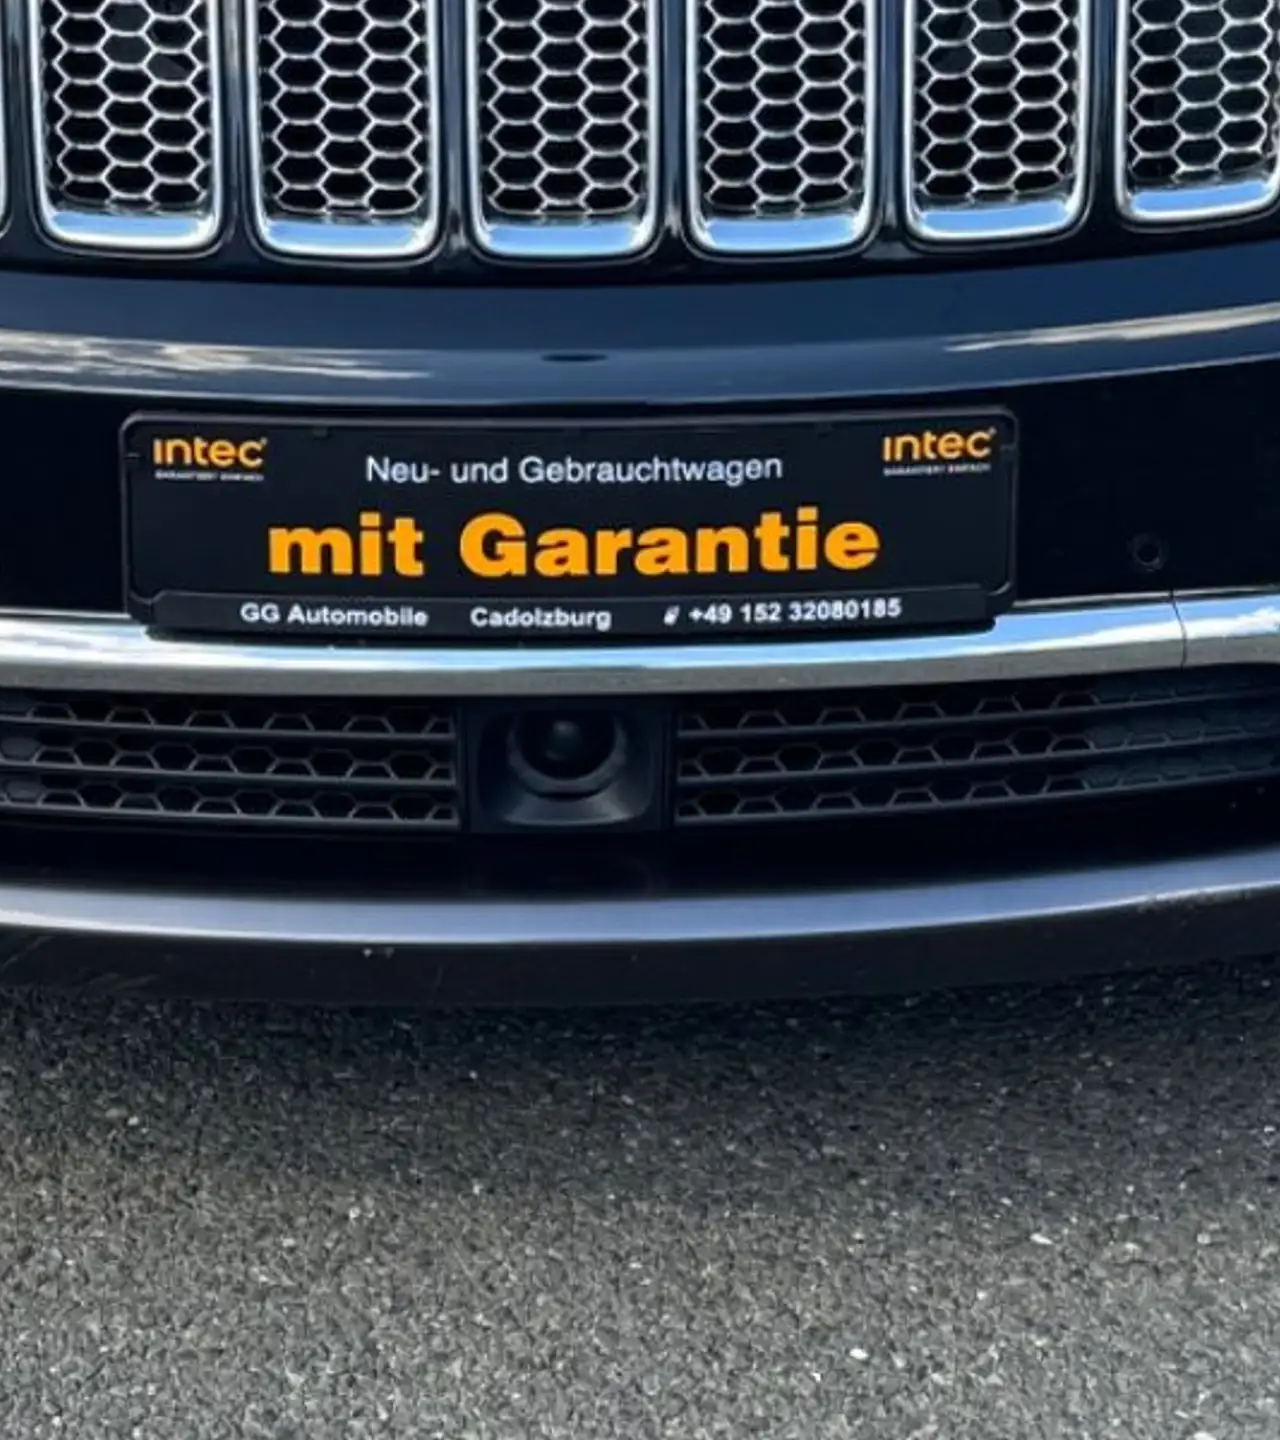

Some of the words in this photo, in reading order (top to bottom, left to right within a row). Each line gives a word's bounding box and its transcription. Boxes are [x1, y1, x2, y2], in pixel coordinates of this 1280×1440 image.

[153, 436, 264, 468] intec
[883, 429, 992, 462] intec
[366, 455, 440, 484] Neu-
[451, 456, 509, 484] und
[518, 455, 783, 487] Gebrauchtwagen
[269, 511, 424, 577] mit
[459, 505, 881, 578] Garantie
[240, 601, 281, 623] GG
[286, 603, 430, 627] Automobile
[470, 606, 613, 632] Cadolzburg
[689, 603, 733, 624] +49
[740, 601, 783, 623] 152
[788, 596, 903, 622] 32080185
